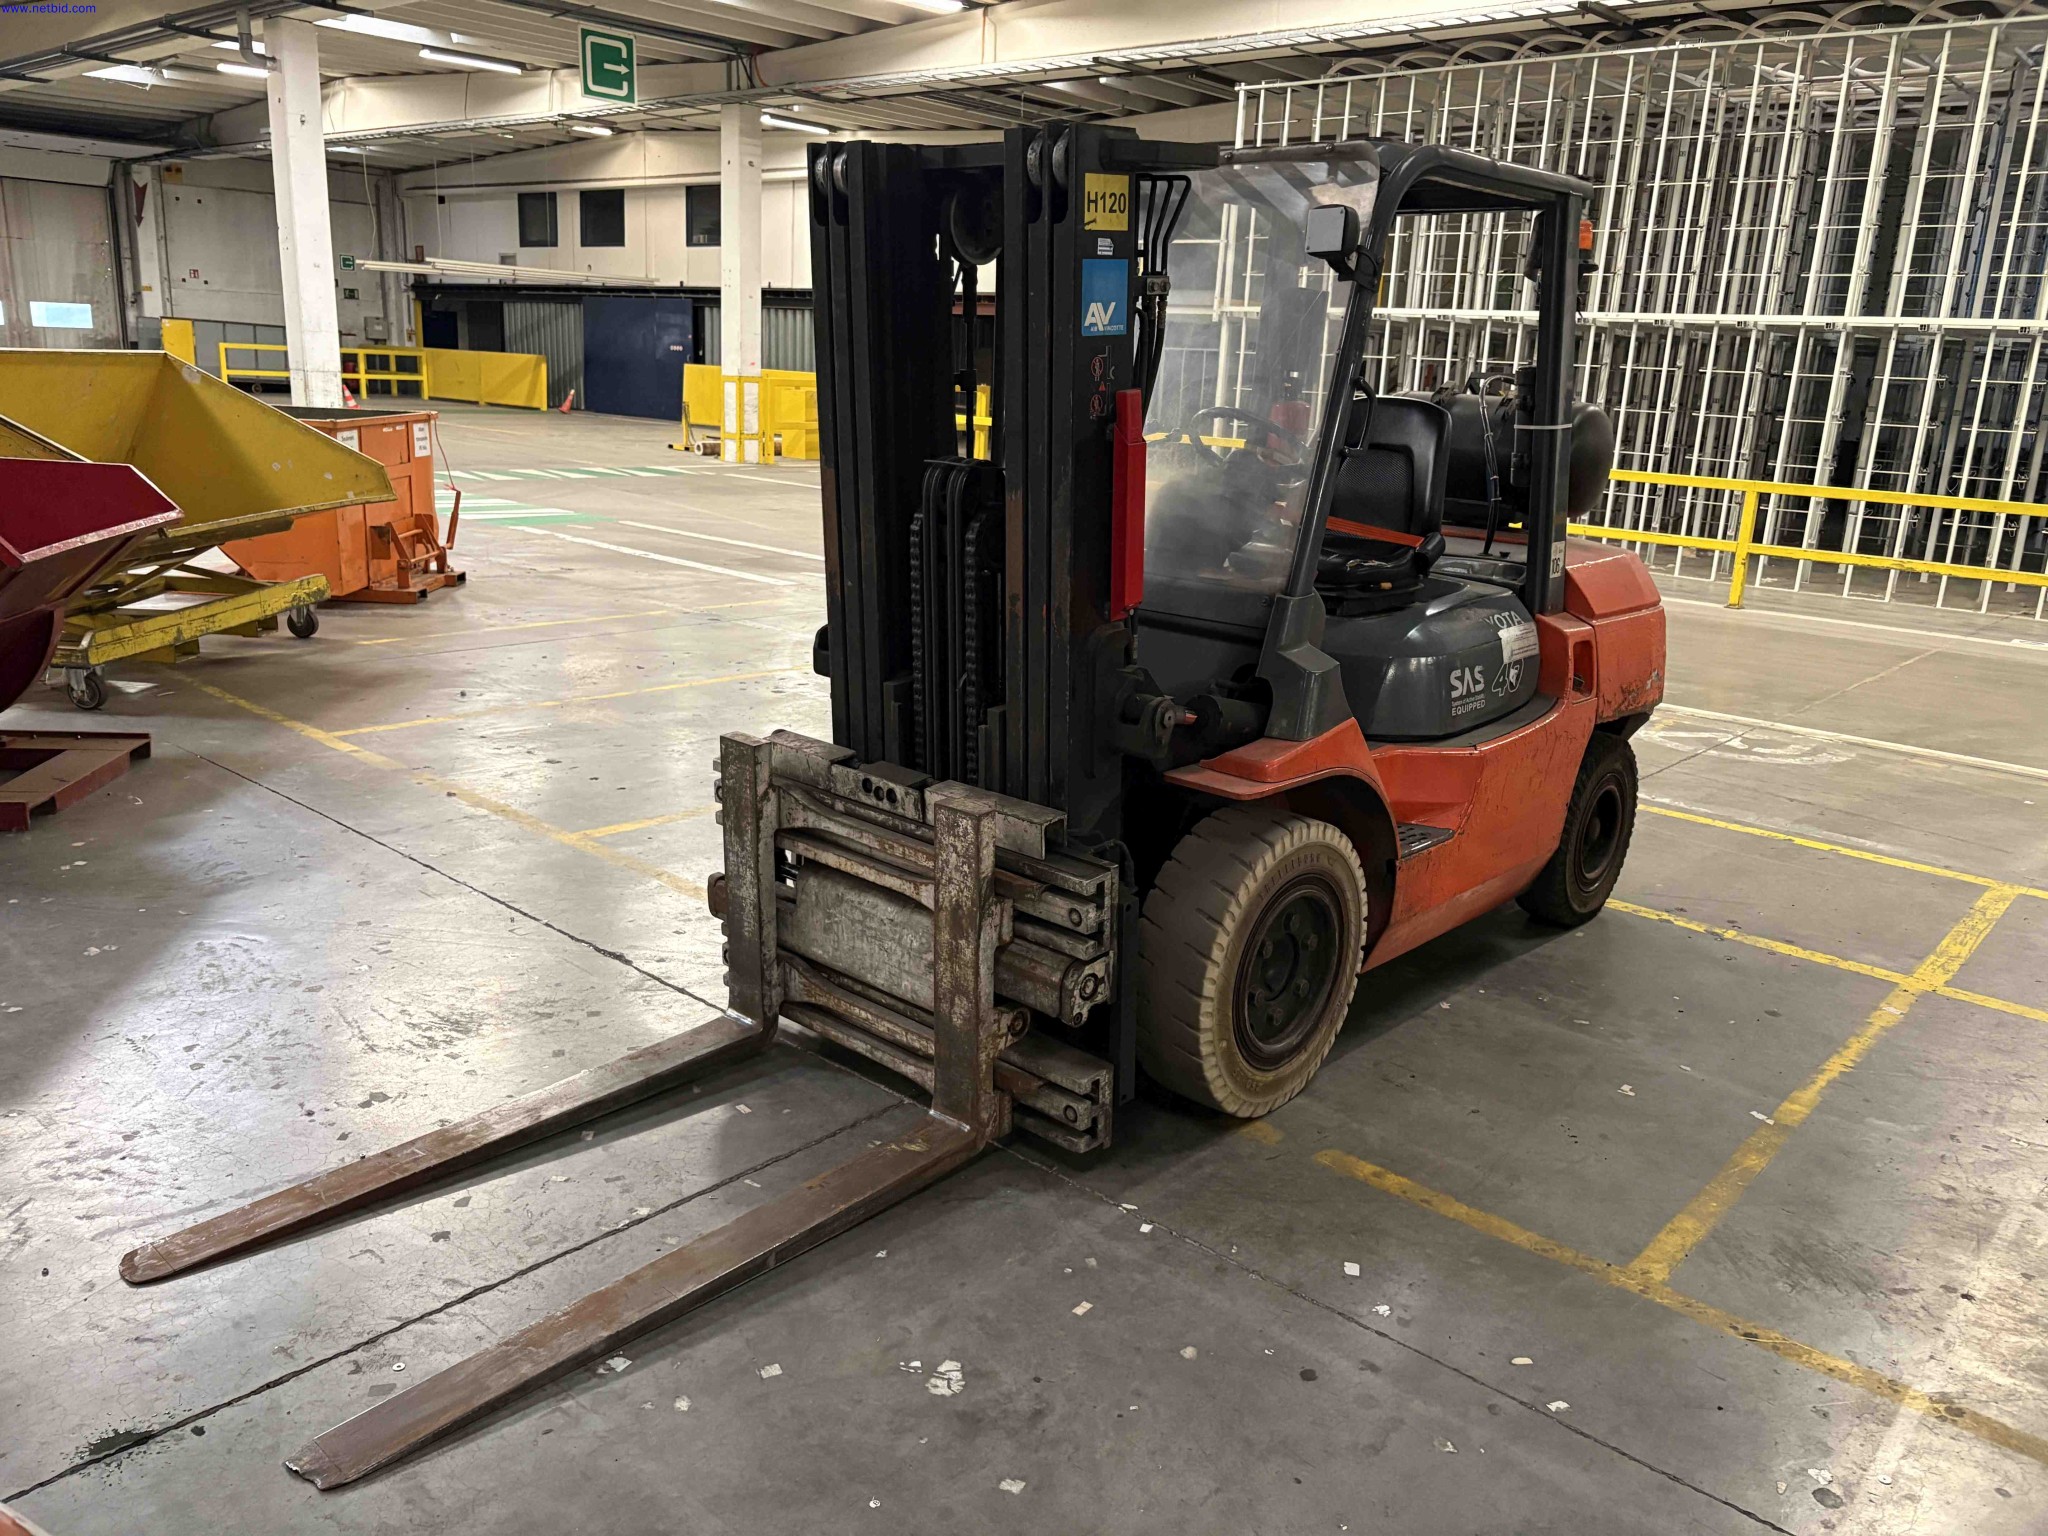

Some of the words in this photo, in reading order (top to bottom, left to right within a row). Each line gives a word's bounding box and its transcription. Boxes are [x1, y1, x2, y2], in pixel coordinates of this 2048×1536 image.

[1087, 191, 1127, 214] H120
[1084, 301, 1116, 332] AV
[1483, 610, 1526, 630] YOTA
[1450, 665, 1485, 698] SAS
[1451, 700, 1486, 716] EQUIPPED
